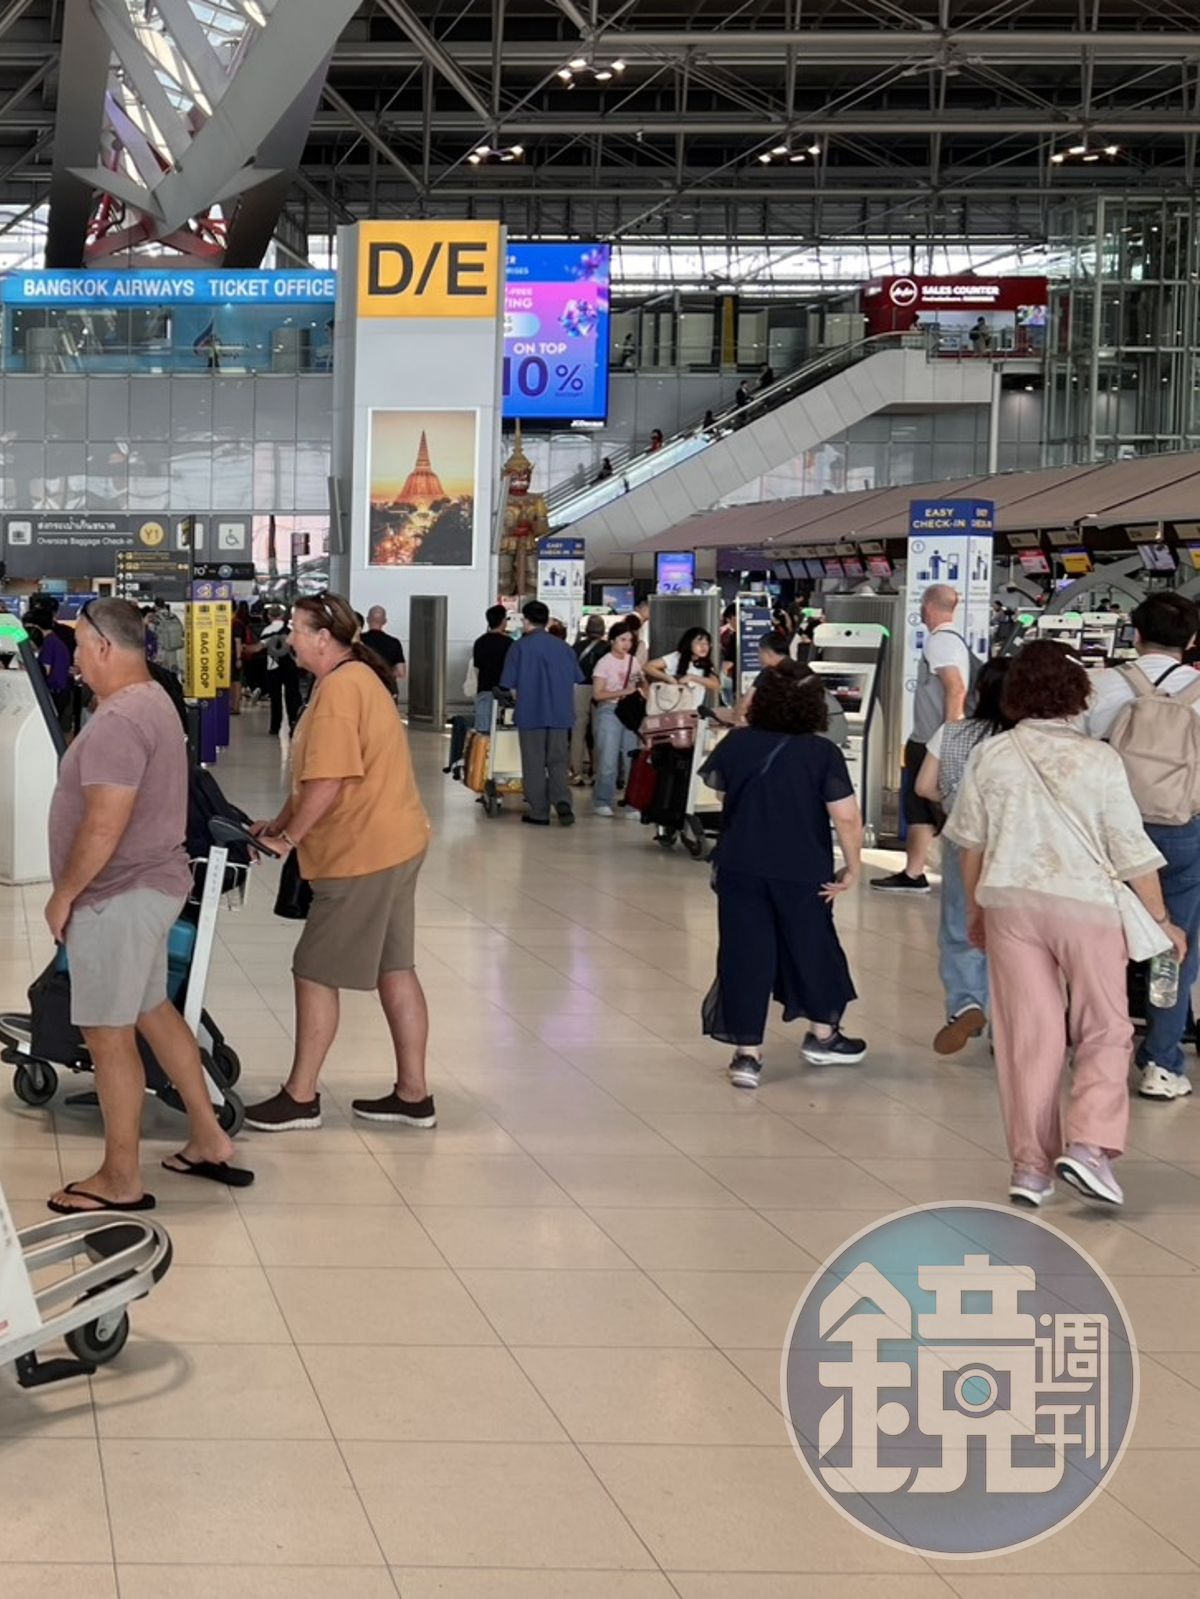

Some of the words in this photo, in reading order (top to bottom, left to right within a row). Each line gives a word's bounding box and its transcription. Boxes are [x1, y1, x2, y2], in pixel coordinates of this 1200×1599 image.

[368, 241, 487, 295] D/E
[23, 279, 107, 296] BANGKOK
[113, 279, 194, 296] AIRWAYS
[208, 279, 269, 296] TICKET
[274, 279, 334, 296] OFFICE
[922, 285, 952, 295] SALES
[953, 285, 999, 296] COUNTER
[513, 342, 535, 354] ON
[539, 342, 567, 354] TOP
[925, 508, 954, 517] EASY
[912, 520, 966, 529] CHECK-IN
[37, 537, 68, 545] Oversize
[70, 537, 101, 546] Baggage
[102, 537, 134, 545] Check-in
[144, 529, 160, 540] Y1
[200, 631, 209, 654] BAG
[217, 628, 225, 649] BAG
[216, 651, 225, 679] DROP
[200, 657, 210, 688] DROP
